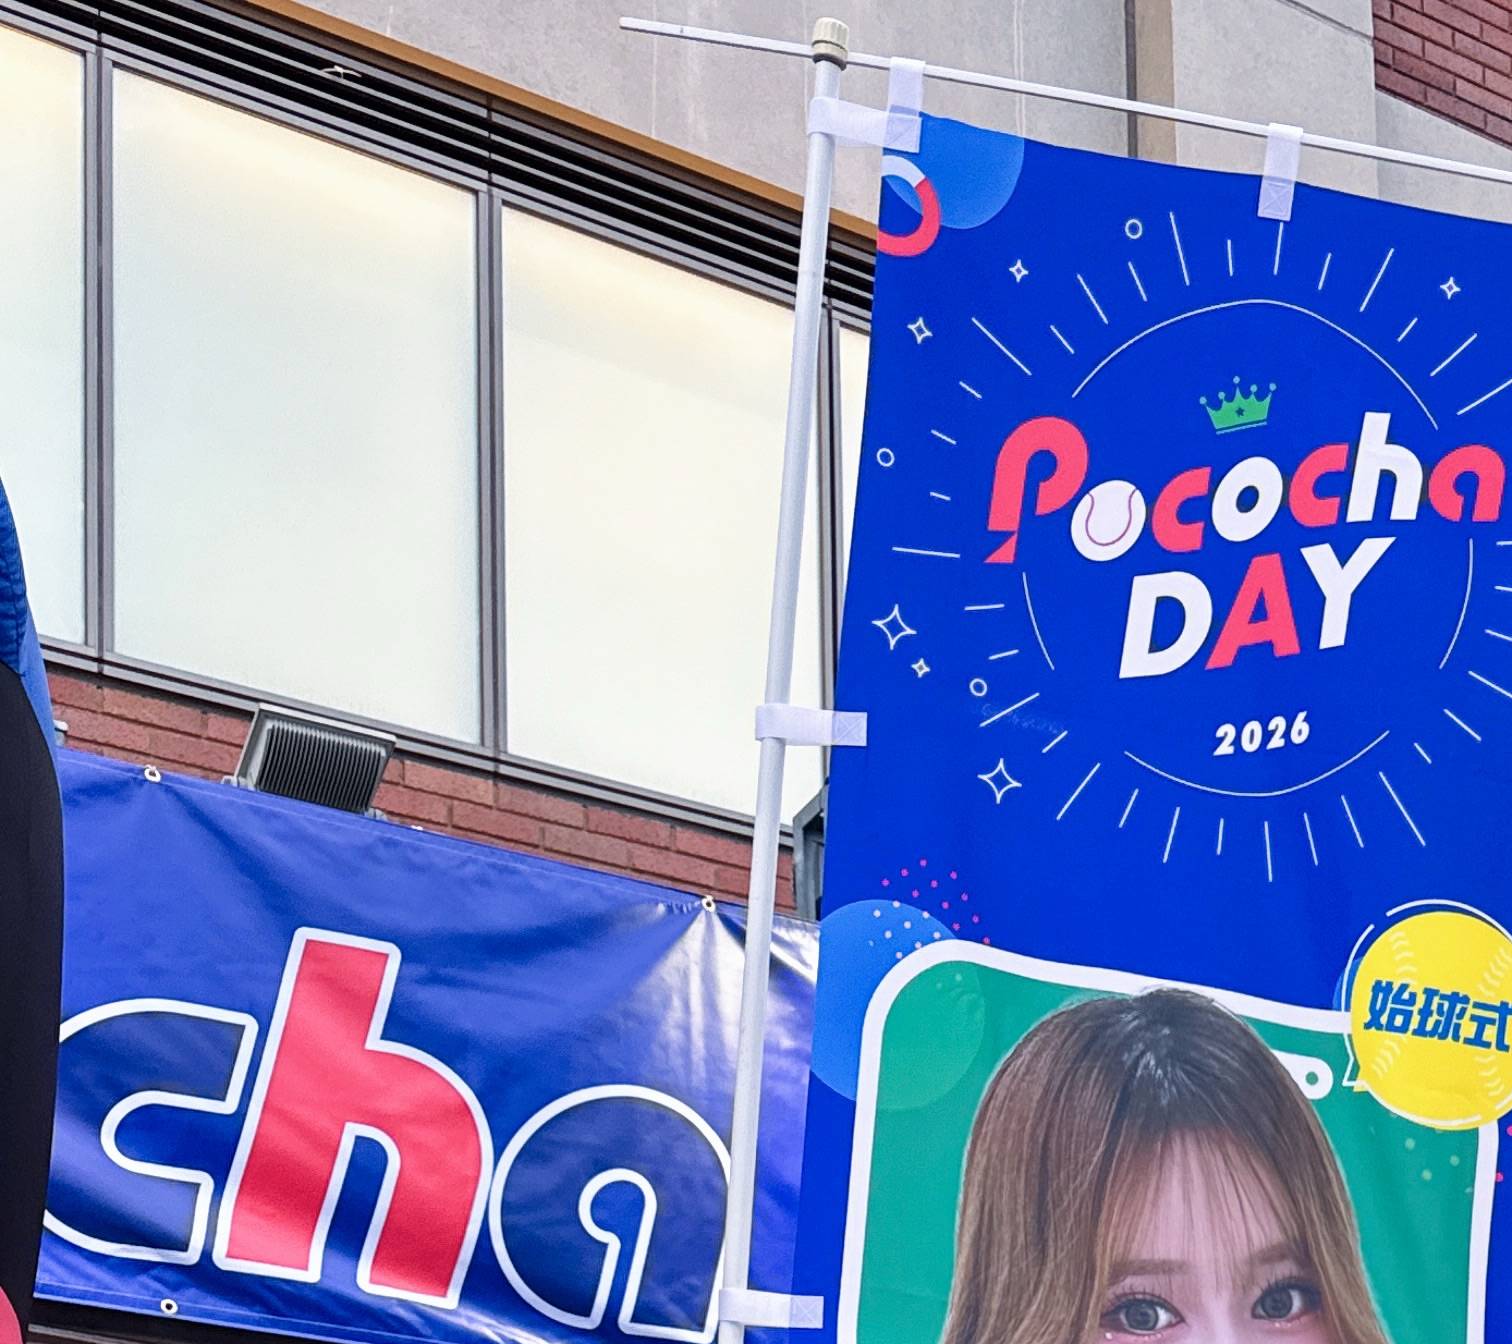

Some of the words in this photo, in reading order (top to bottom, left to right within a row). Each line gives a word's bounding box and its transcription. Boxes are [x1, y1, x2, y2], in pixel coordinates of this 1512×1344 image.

[983, 412, 1507, 564] Pococha
[1118, 536, 1399, 680] DAY
[1213, 711, 1312, 756] 2026
